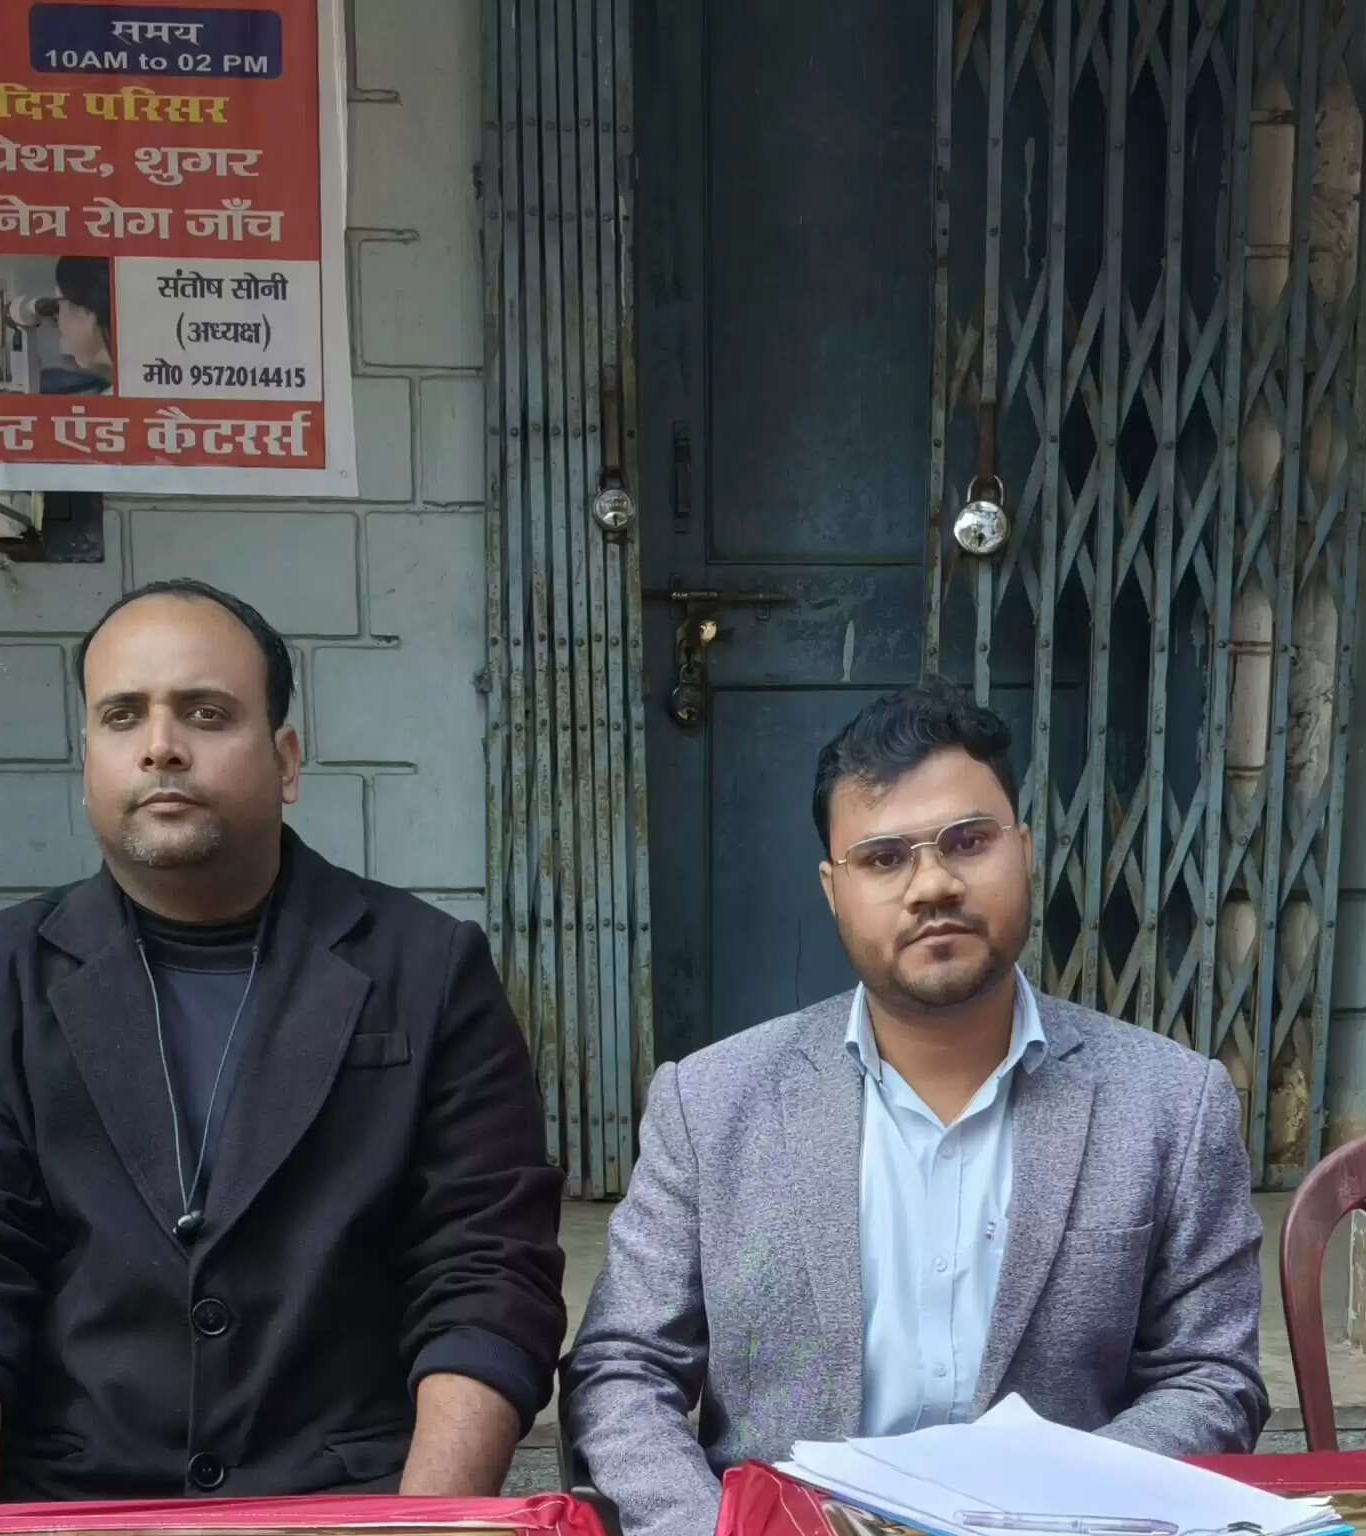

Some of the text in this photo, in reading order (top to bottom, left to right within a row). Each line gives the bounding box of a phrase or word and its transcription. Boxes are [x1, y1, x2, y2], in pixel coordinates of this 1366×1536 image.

[111, 20, 204, 46] समय
[45, 49, 268, 73] 10AM to 02 PM
[84, 86, 230, 124] परिसर
[135, 147, 263, 186] शुगर
[84, 197, 173, 240] रोग
[186, 198, 284, 242] जाँच
[157, 271, 288, 302] संतोष सोनी
[176, 313, 271, 352] (अध्यक्ष)
[190, 365, 306, 388] 9572014415
[51, 407, 129, 454] एंड
[144, 406, 312, 457] कैटरर्स
